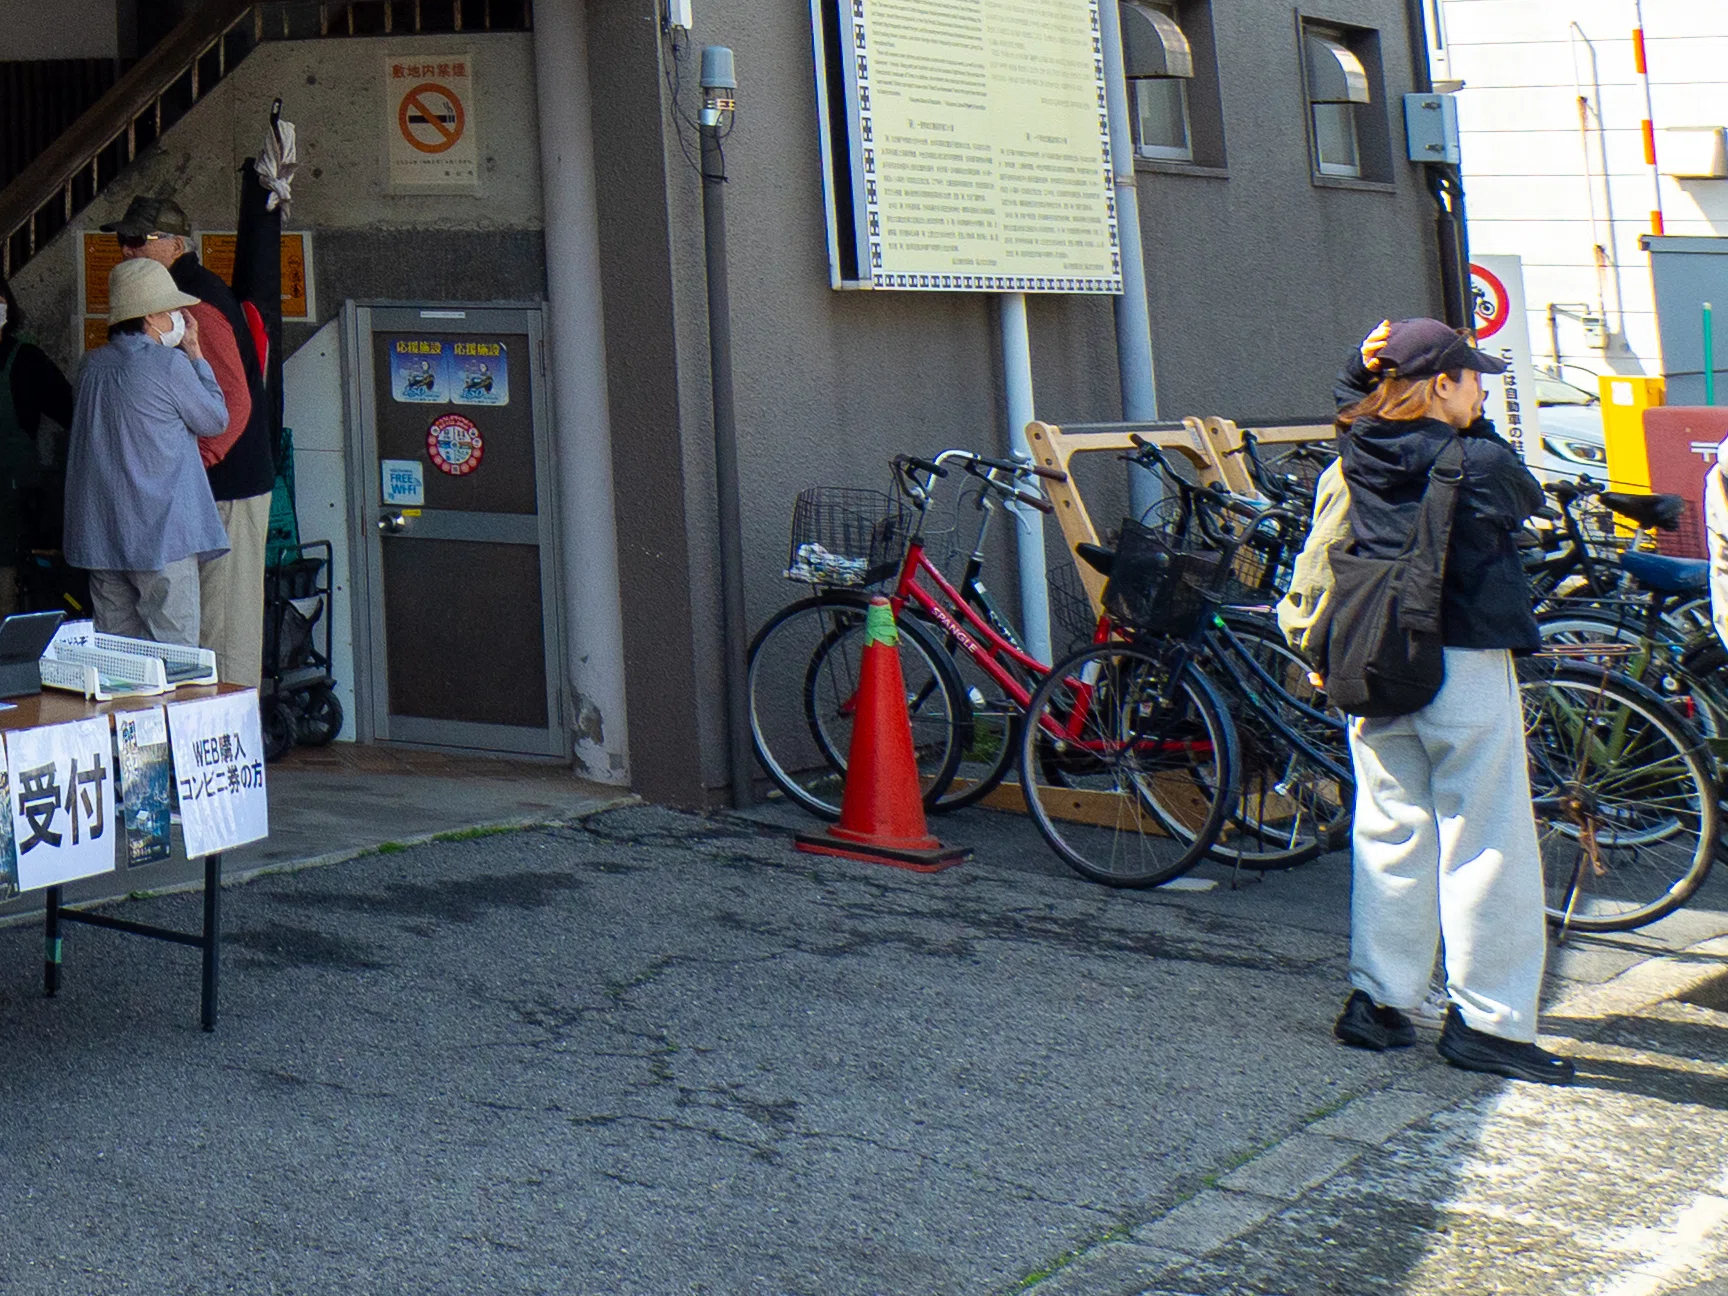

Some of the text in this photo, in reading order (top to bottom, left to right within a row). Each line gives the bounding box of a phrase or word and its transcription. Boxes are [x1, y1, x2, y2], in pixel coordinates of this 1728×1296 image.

[391, 61, 469, 82] 敷地内禁煙
[395, 340, 442, 355] 応援施設
[453, 342, 501, 357] 応援施設
[389, 473, 414, 484] FREE
[191, 731, 248, 763] WEB購入
[178, 757, 263, 804] コンビニ券の方
[18, 752, 107, 856] 受付
